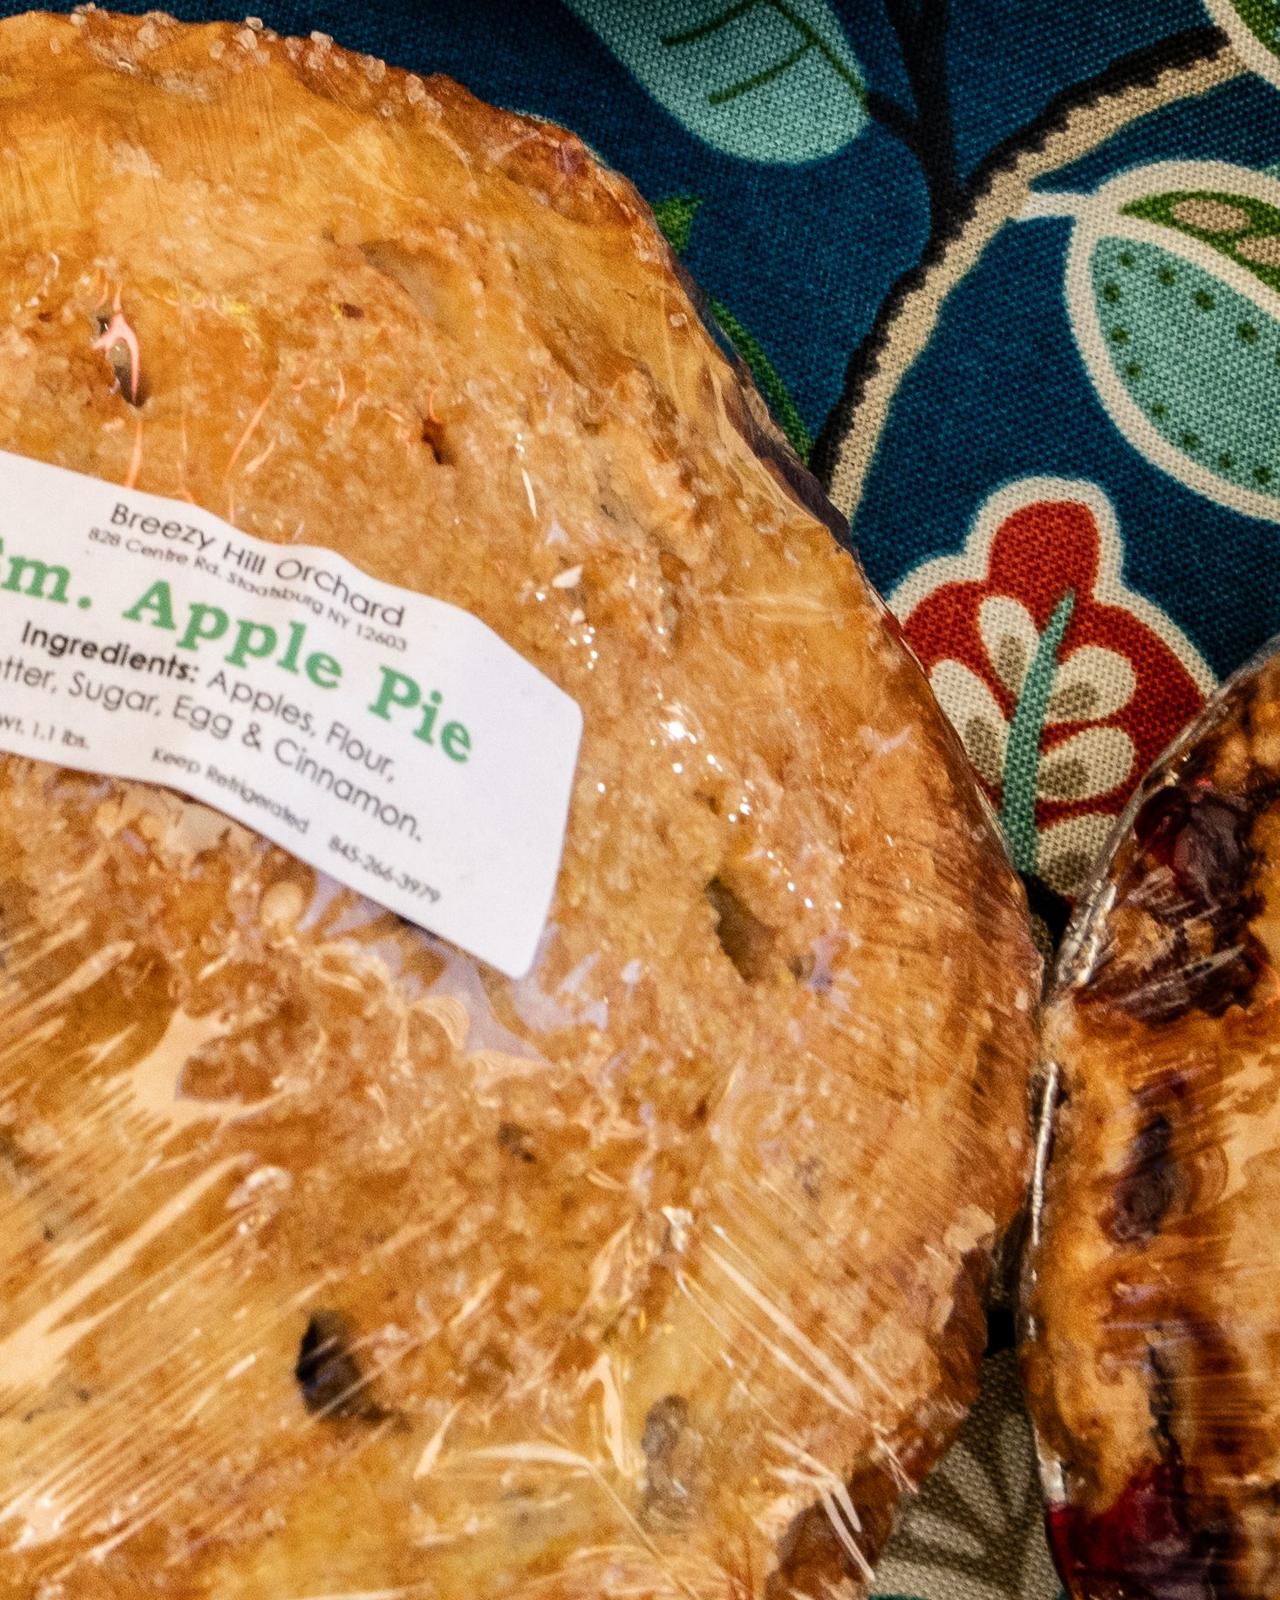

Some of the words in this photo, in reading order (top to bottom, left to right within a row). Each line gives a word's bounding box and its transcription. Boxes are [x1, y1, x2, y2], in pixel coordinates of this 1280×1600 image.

[109, 502, 216, 552] Breezy
[222, 541, 267, 576] Hill
[274, 558, 406, 628] Orchard
[21, 620, 199, 683] Ingredients:
[206, 669, 316, 738] Apples,
[325, 720, 395, 784] Flour,
[121, 579, 345, 689] Apple
[368, 667, 471, 764] Pie
[67, 670, 161, 717] Sugar,
[172, 694, 234, 741] Egg
[241, 721, 262, 752] &
[273, 737, 422, 843] Cinnamon.
[151, 747, 201, 774] Keep
[205, 764, 310, 835] Refrigerated
[327, 834, 441, 904] 845-266-3979
